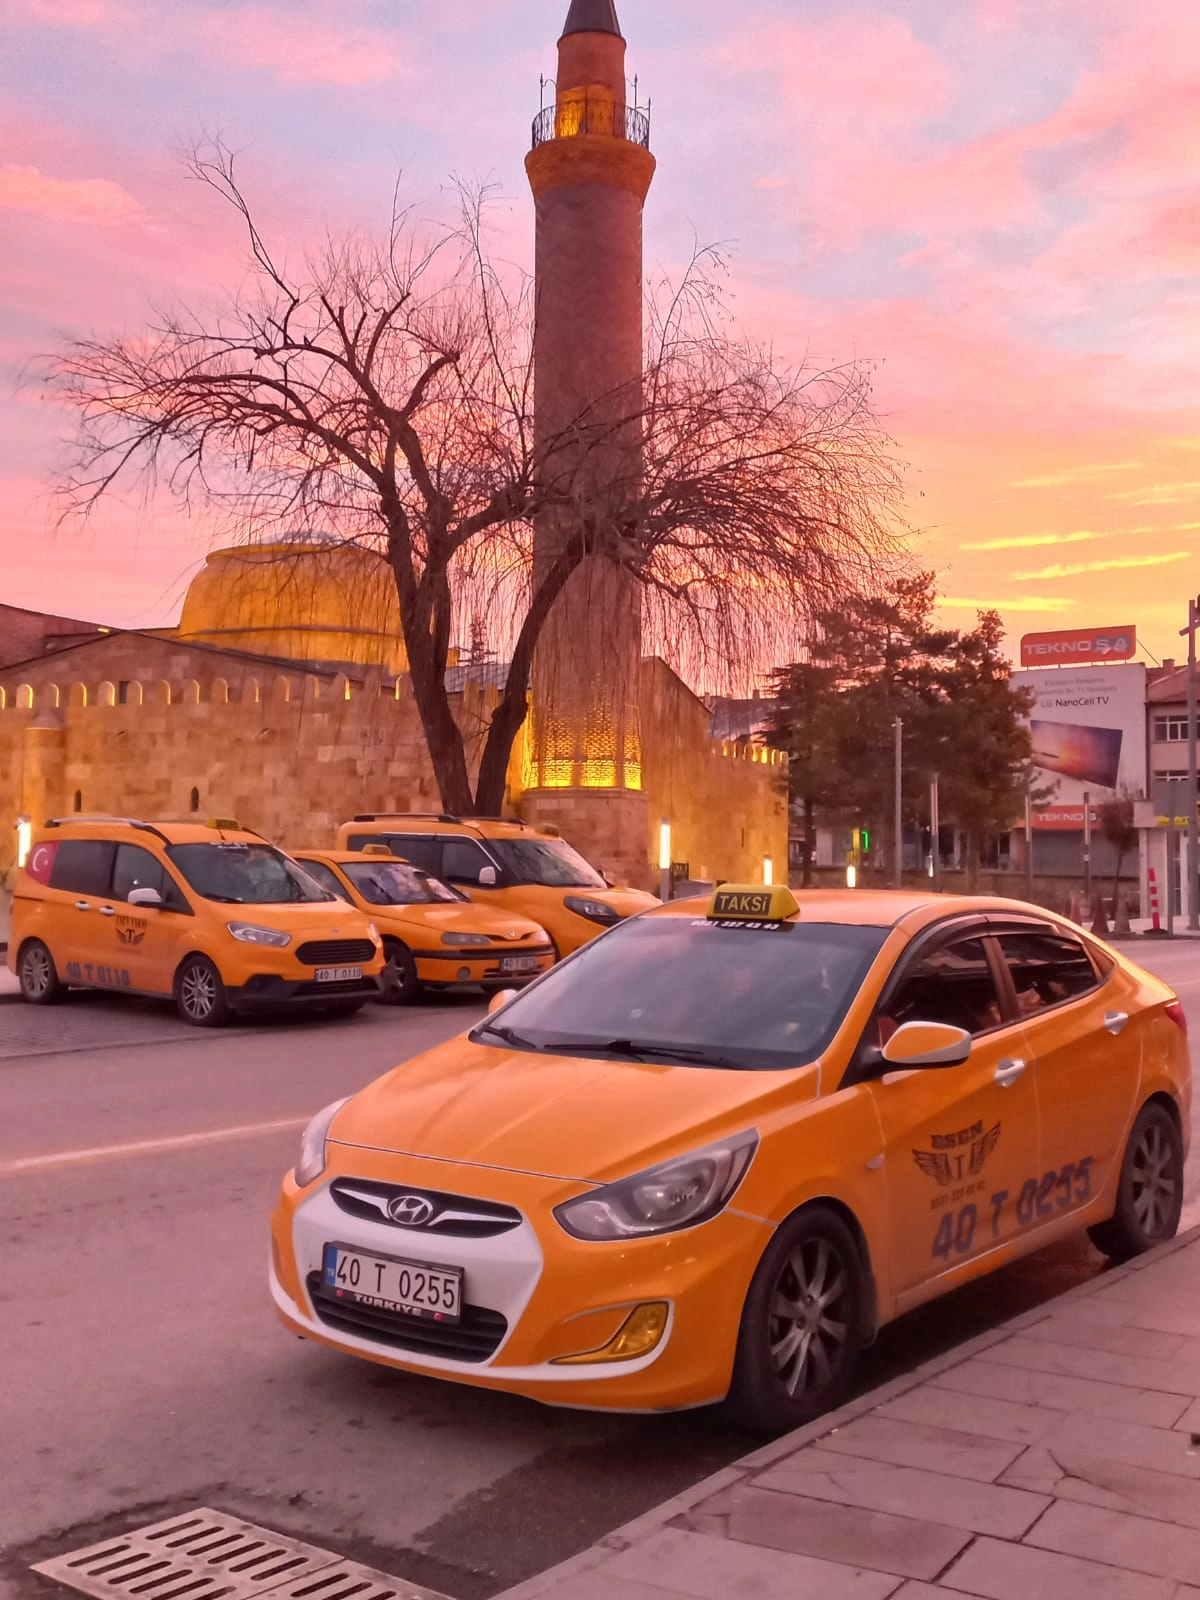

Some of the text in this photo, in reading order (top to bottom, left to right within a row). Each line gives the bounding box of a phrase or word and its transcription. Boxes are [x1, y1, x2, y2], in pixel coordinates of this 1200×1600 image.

[1024, 637, 1129, 656] TEKNOSA
[1055, 697, 1094, 707] NanoCell
[1097, 697, 1109, 705] TV
[84, 963, 93, 980] T
[319, 970, 329, 980] 40
[343, 968, 360, 979] 0110
[930, 1119, 984, 1150] ESEN
[931, 1157, 1093, 1261] 40 T 0255
[336, 1255, 456, 1309] 40 T 0255
